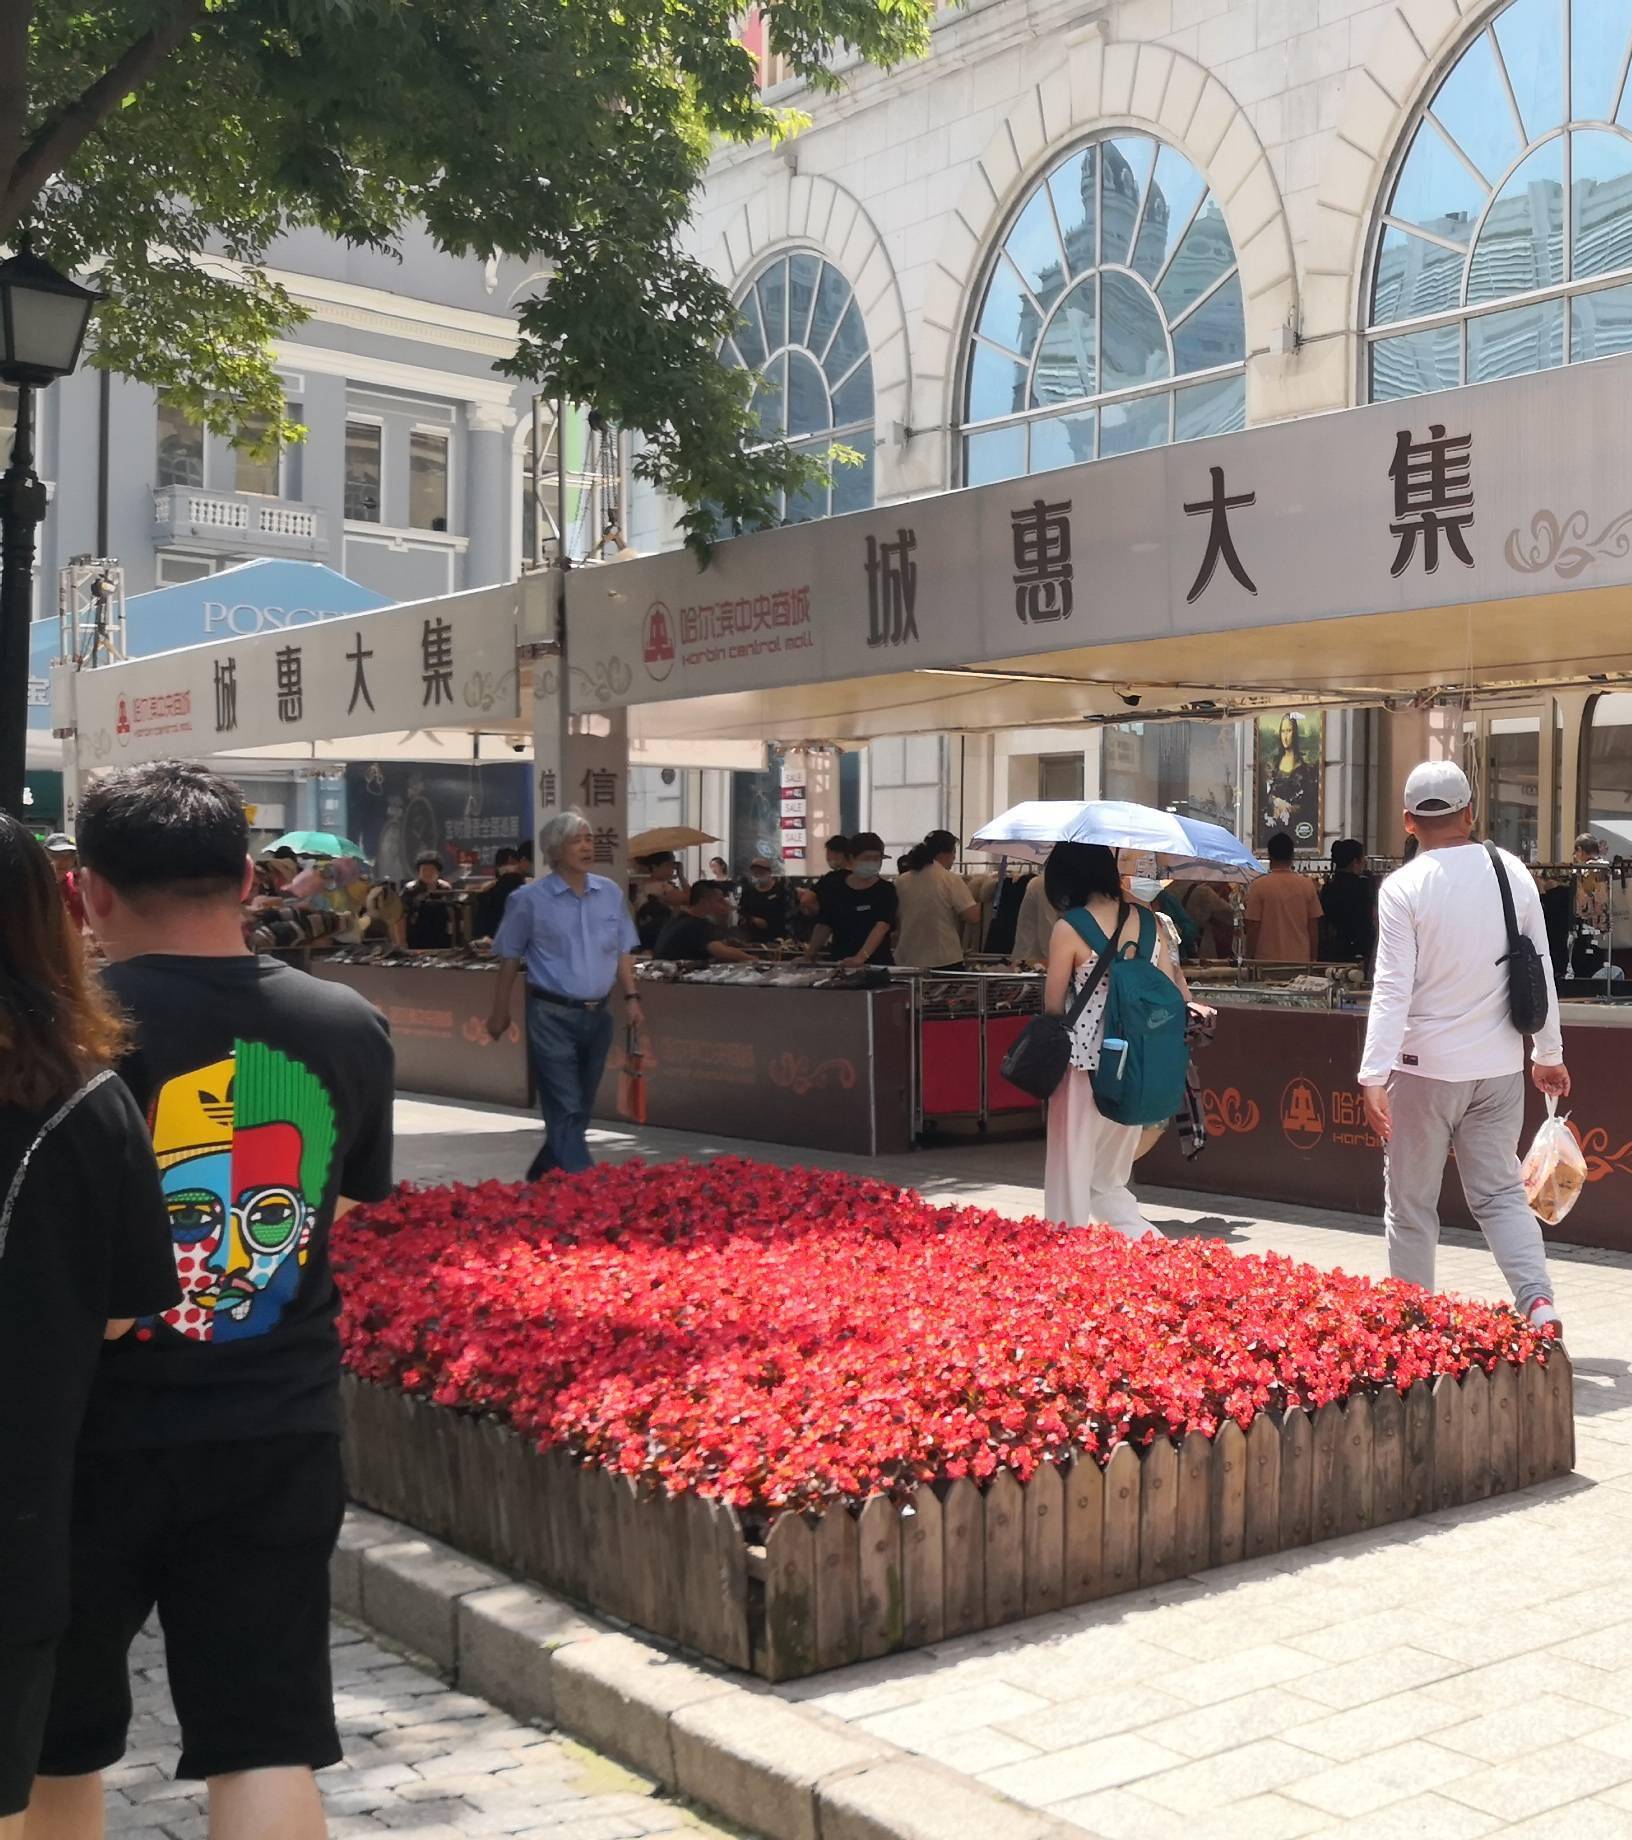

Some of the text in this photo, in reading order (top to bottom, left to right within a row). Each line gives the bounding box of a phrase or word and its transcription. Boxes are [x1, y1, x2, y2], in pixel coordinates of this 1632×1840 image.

[863, 424, 1475, 648] 城惠大集
[680, 585, 811, 644] 哈尔滨中央商城
[213, 616, 456, 733] 城惠大集
[681, 631, 814, 666] Harbin central mall
[1333, 1132, 1384, 1147] Harbi
